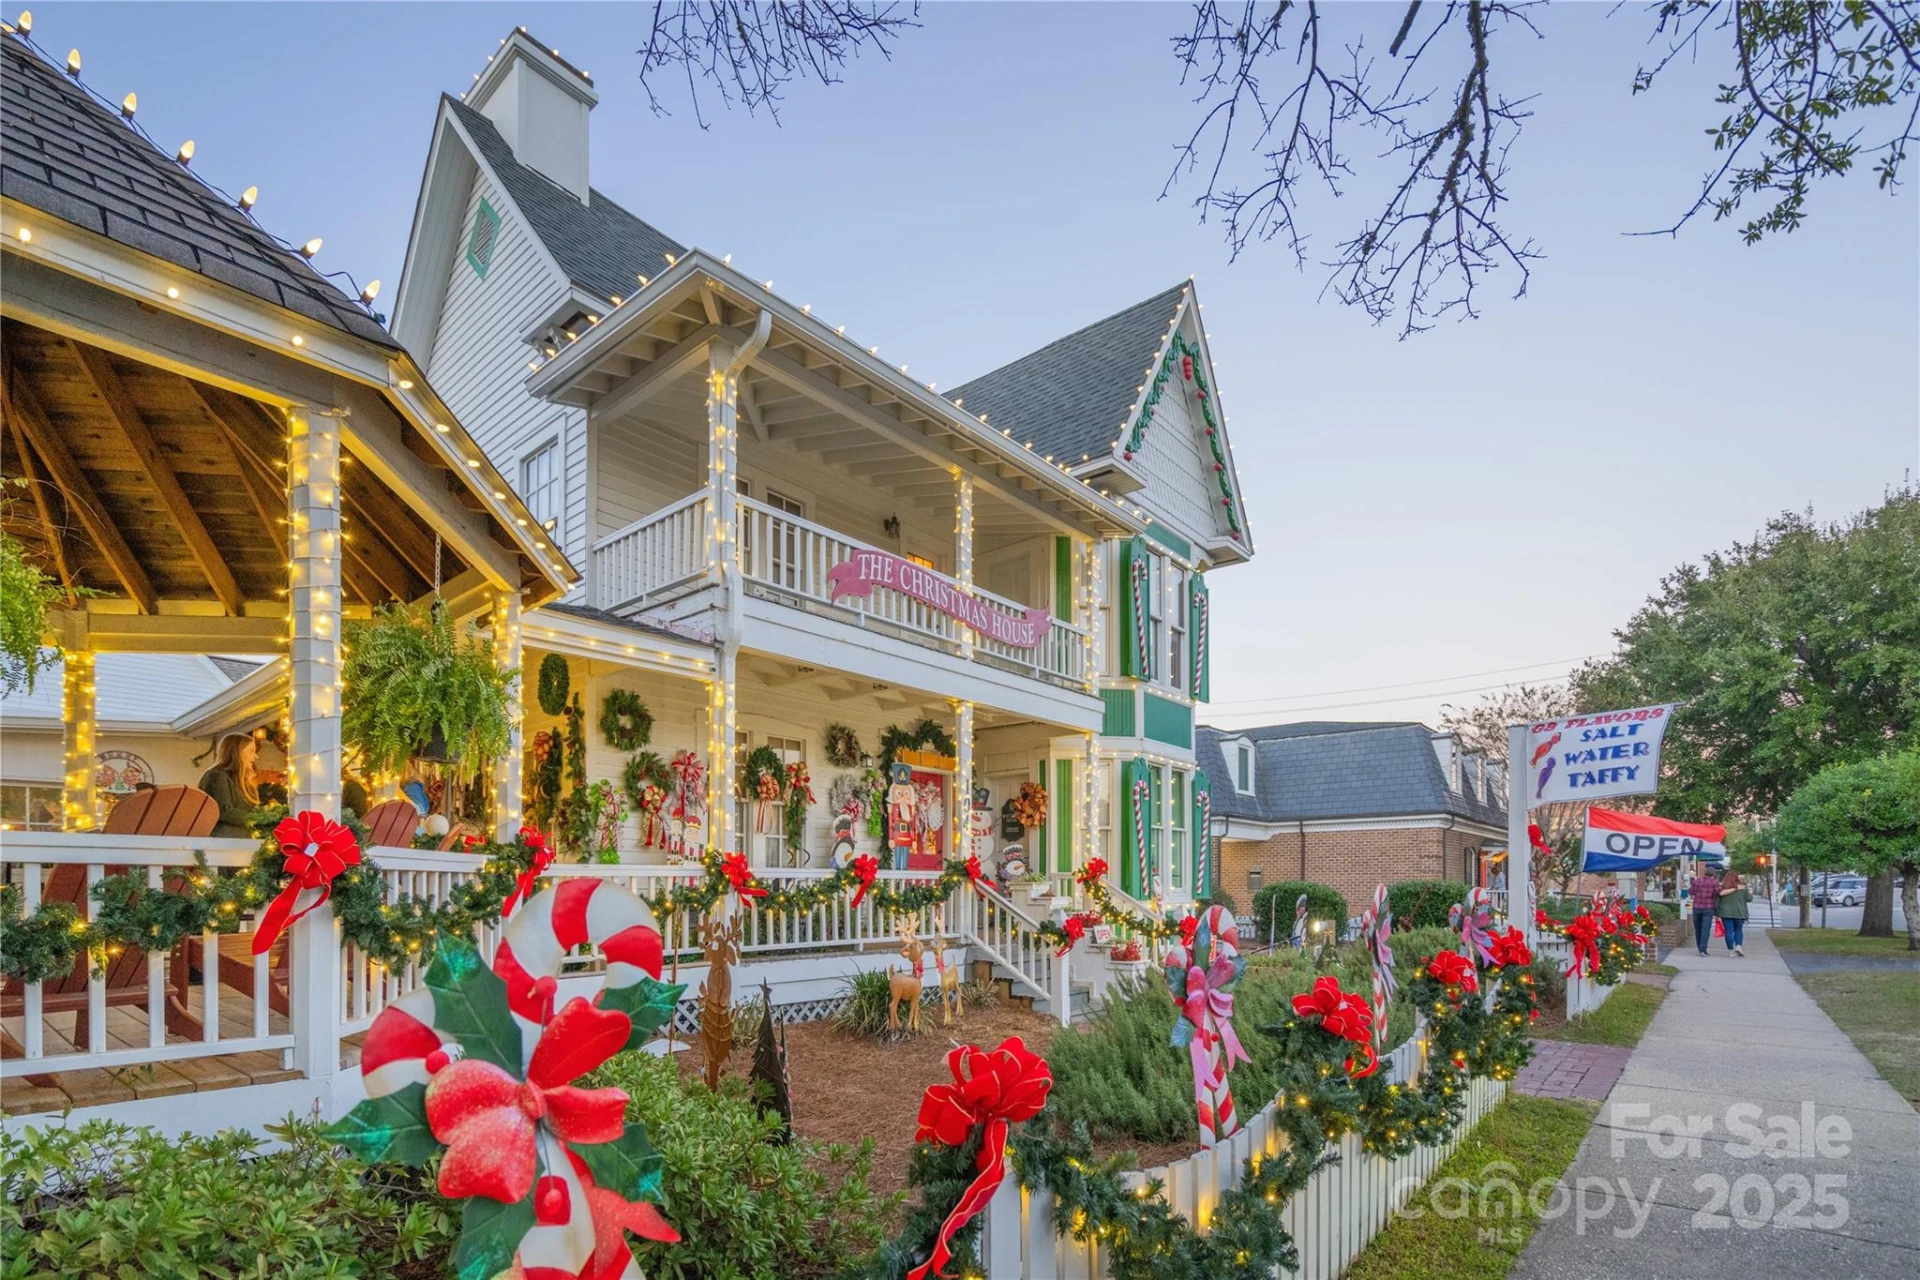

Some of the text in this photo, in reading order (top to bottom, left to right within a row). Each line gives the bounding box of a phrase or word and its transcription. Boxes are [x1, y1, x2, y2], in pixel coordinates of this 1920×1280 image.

[857, 554, 1035, 645] THE CHRISTMAS HOUSE
[1564, 708, 1665, 729] FLAVORS
[1580, 723, 1644, 742] SALT
[1564, 741, 1650, 766] WATER
[1568, 765, 1640, 788] TAFFY
[1606, 833, 1704, 858] OPEN
